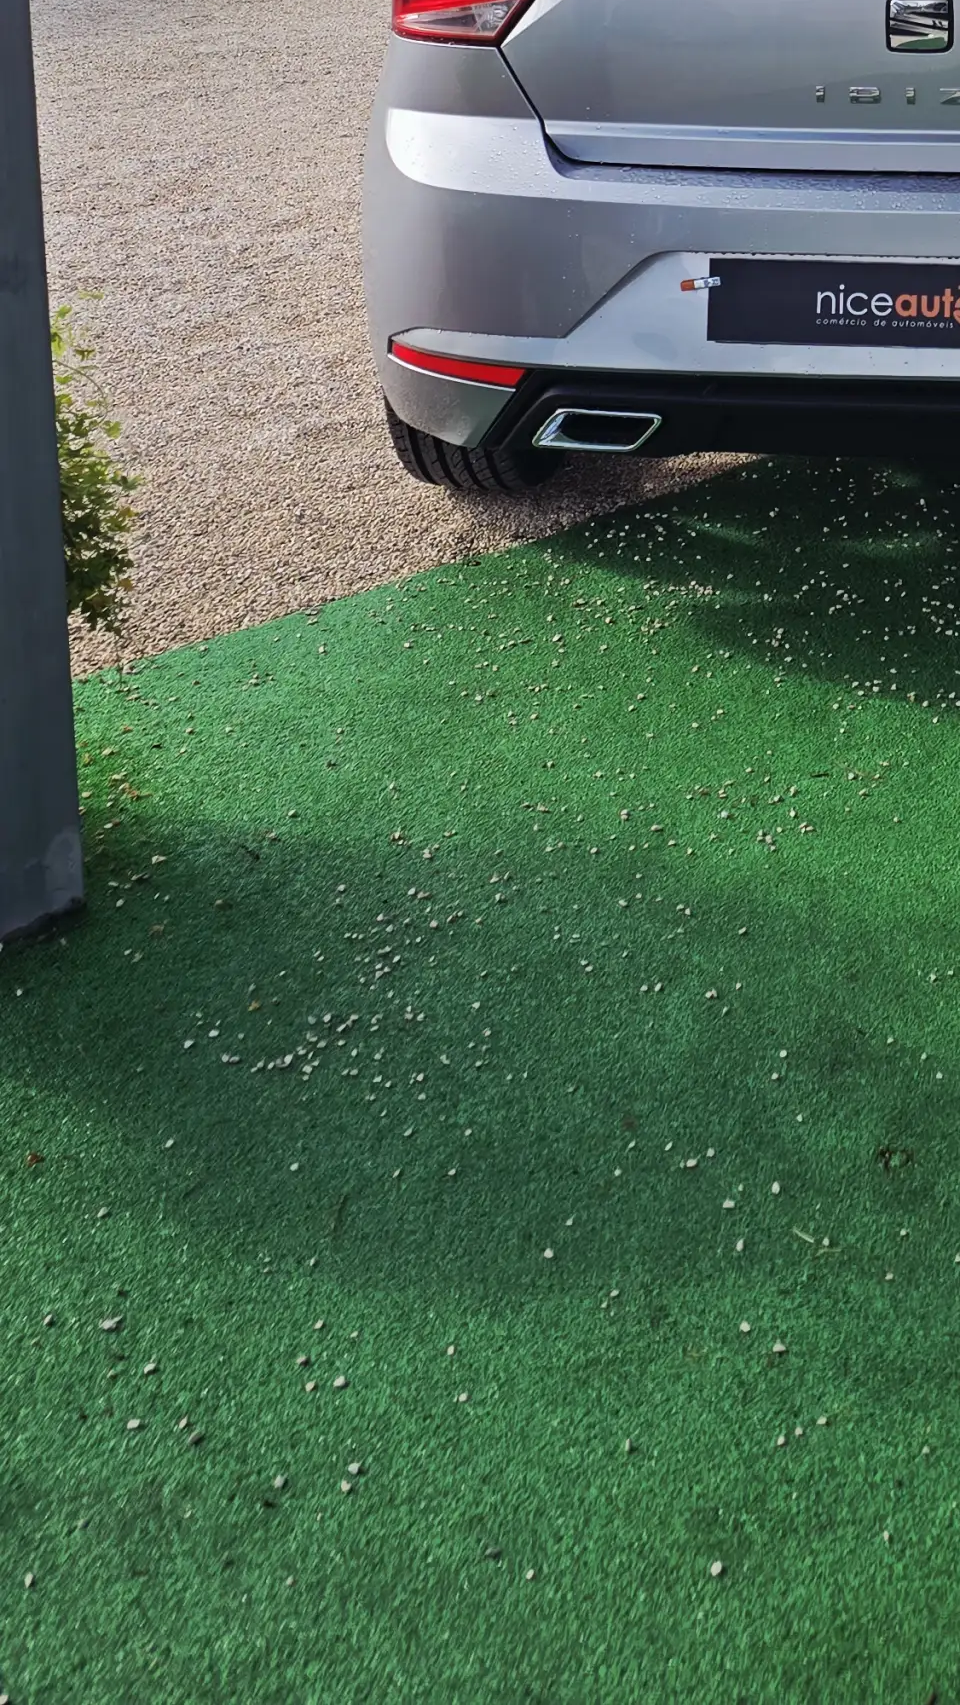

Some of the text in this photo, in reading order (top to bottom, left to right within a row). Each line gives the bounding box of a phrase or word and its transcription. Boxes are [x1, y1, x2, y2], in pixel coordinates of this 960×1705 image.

[816, 317, 954, 329] comércio de automóveis
